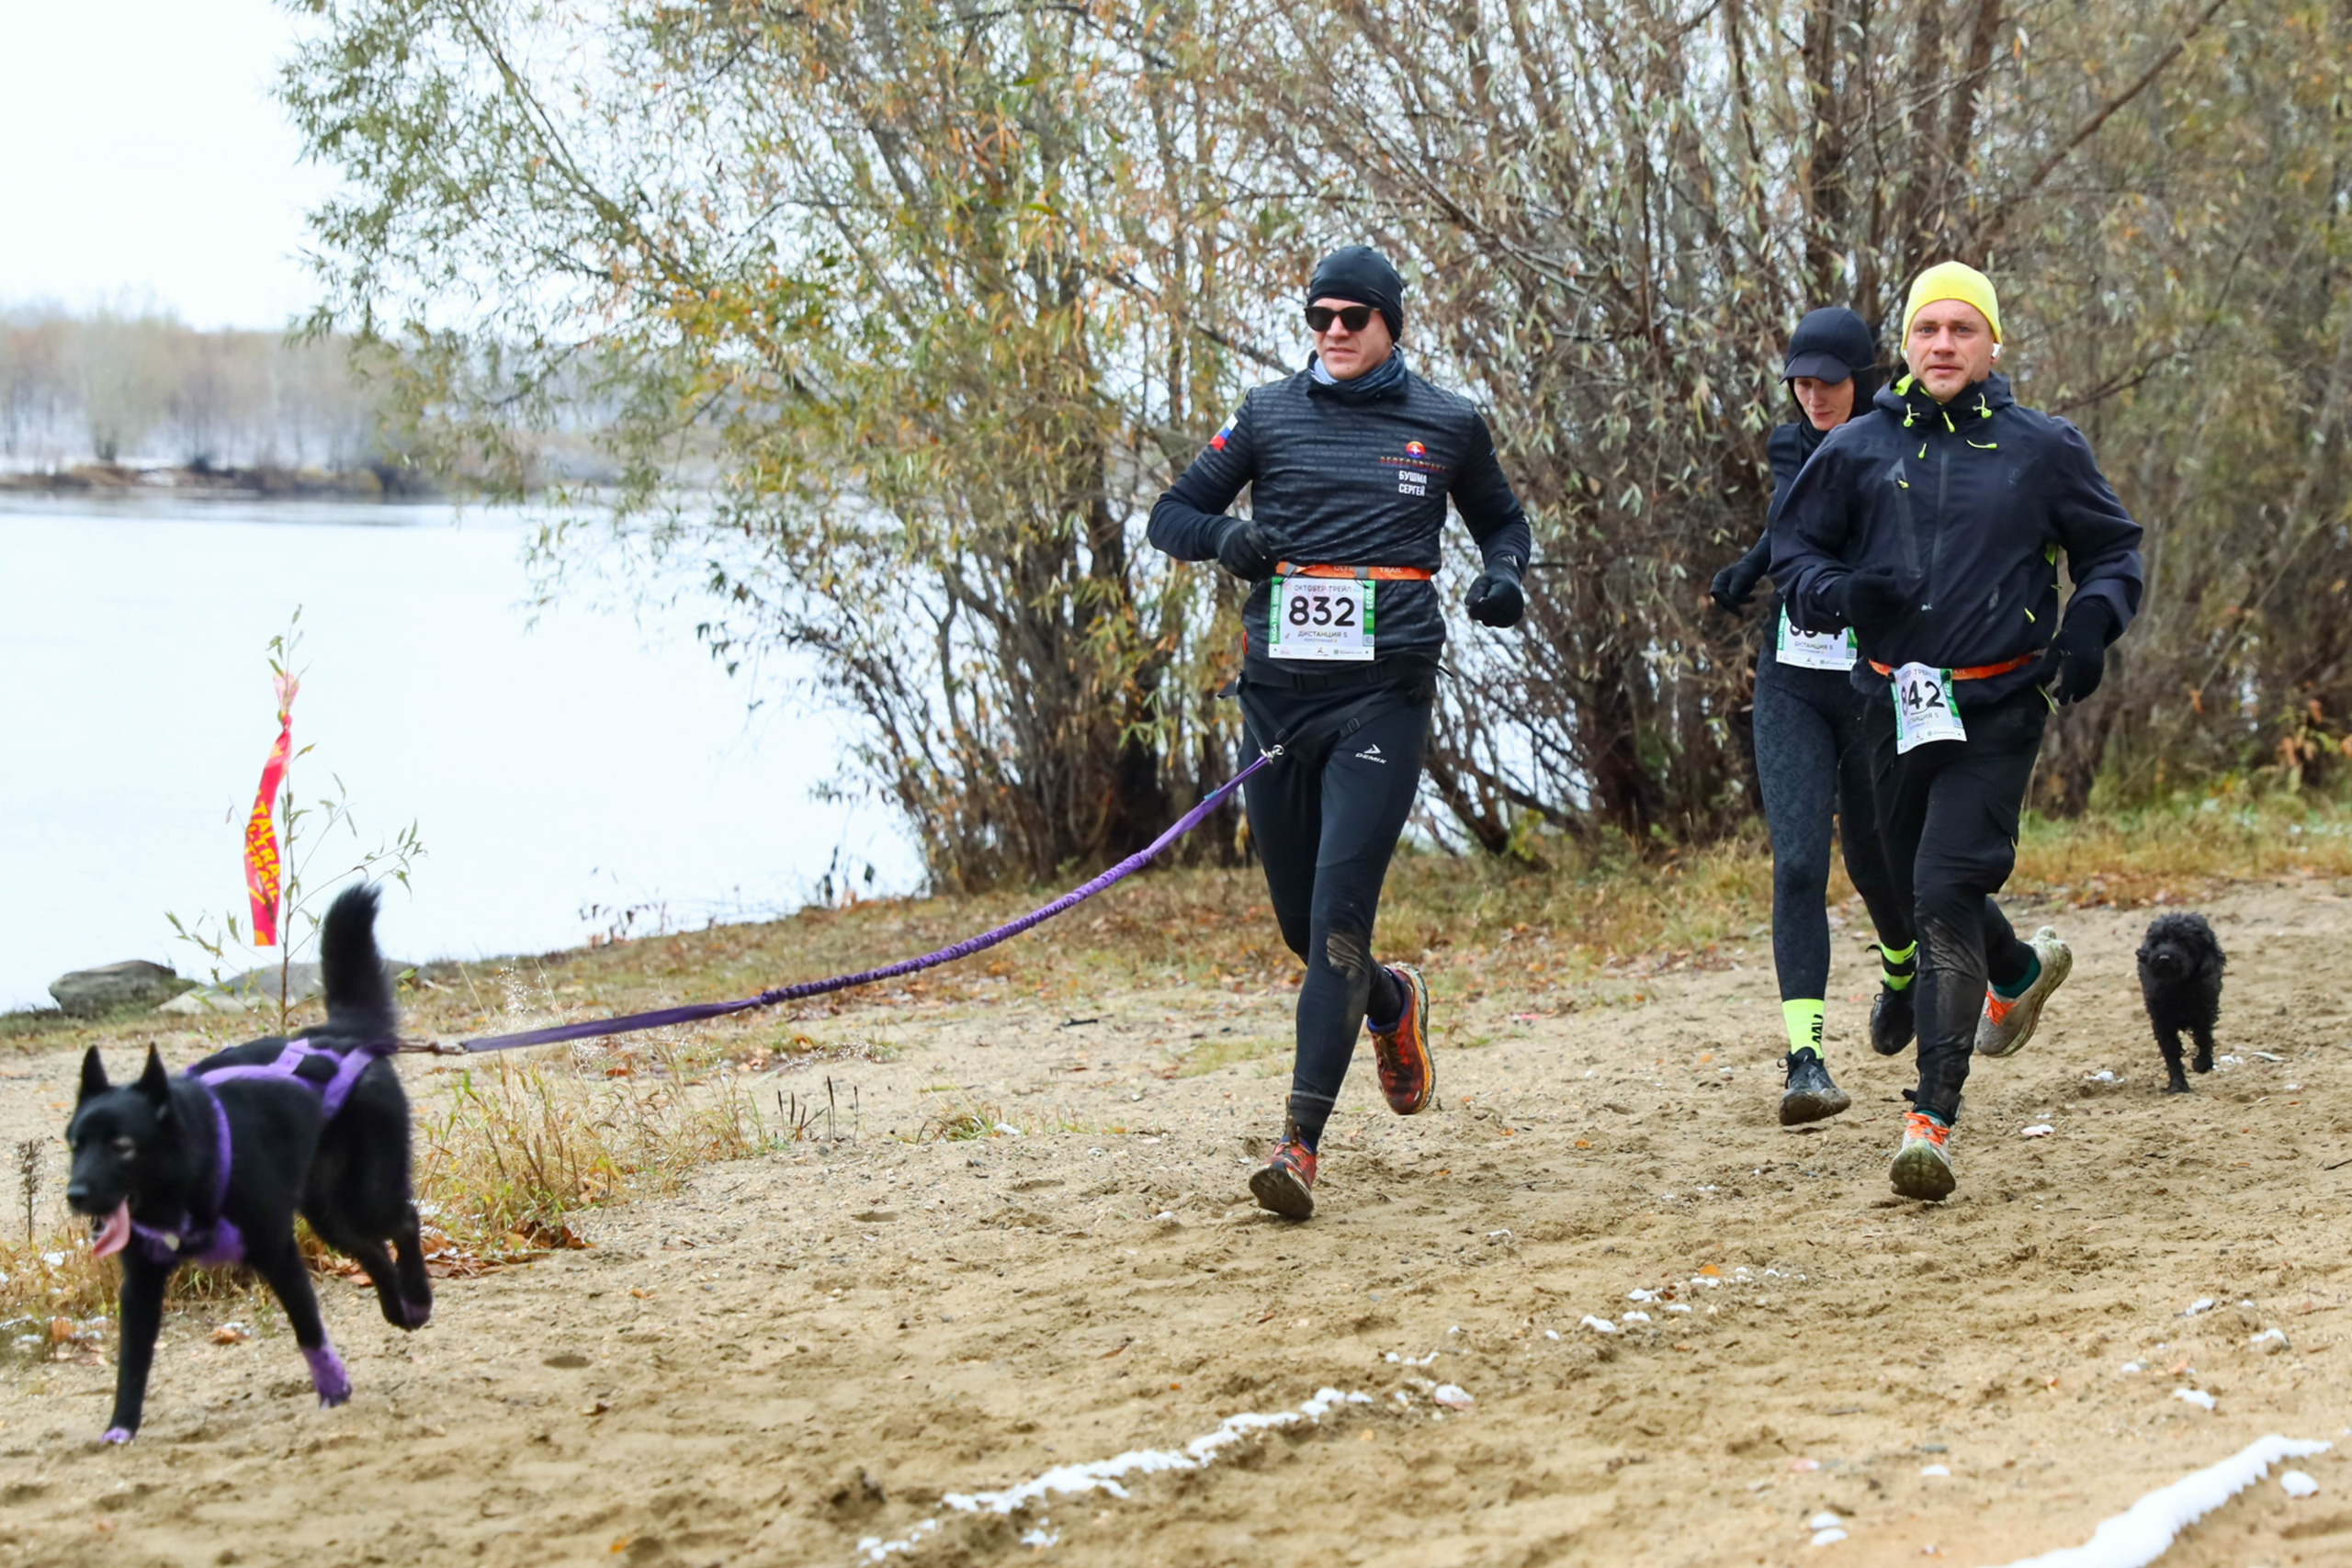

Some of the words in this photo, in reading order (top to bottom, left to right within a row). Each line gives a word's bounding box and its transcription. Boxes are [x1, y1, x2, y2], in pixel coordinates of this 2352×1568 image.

[1398, 484, 1426, 497] СЕРГЕЙ
[1294, 584, 1326, 592] ОКТОБЕР
[1328, 584, 1351, 592] ТРЕЙЛ
[1289, 596, 1355, 626] 832
[1297, 630, 1341, 638] ДИСТАНЦИЯ
[1901, 681, 1946, 716] 842
[1355, 752, 1387, 764] DEMIX
[244, 840, 278, 904] TRAIL
